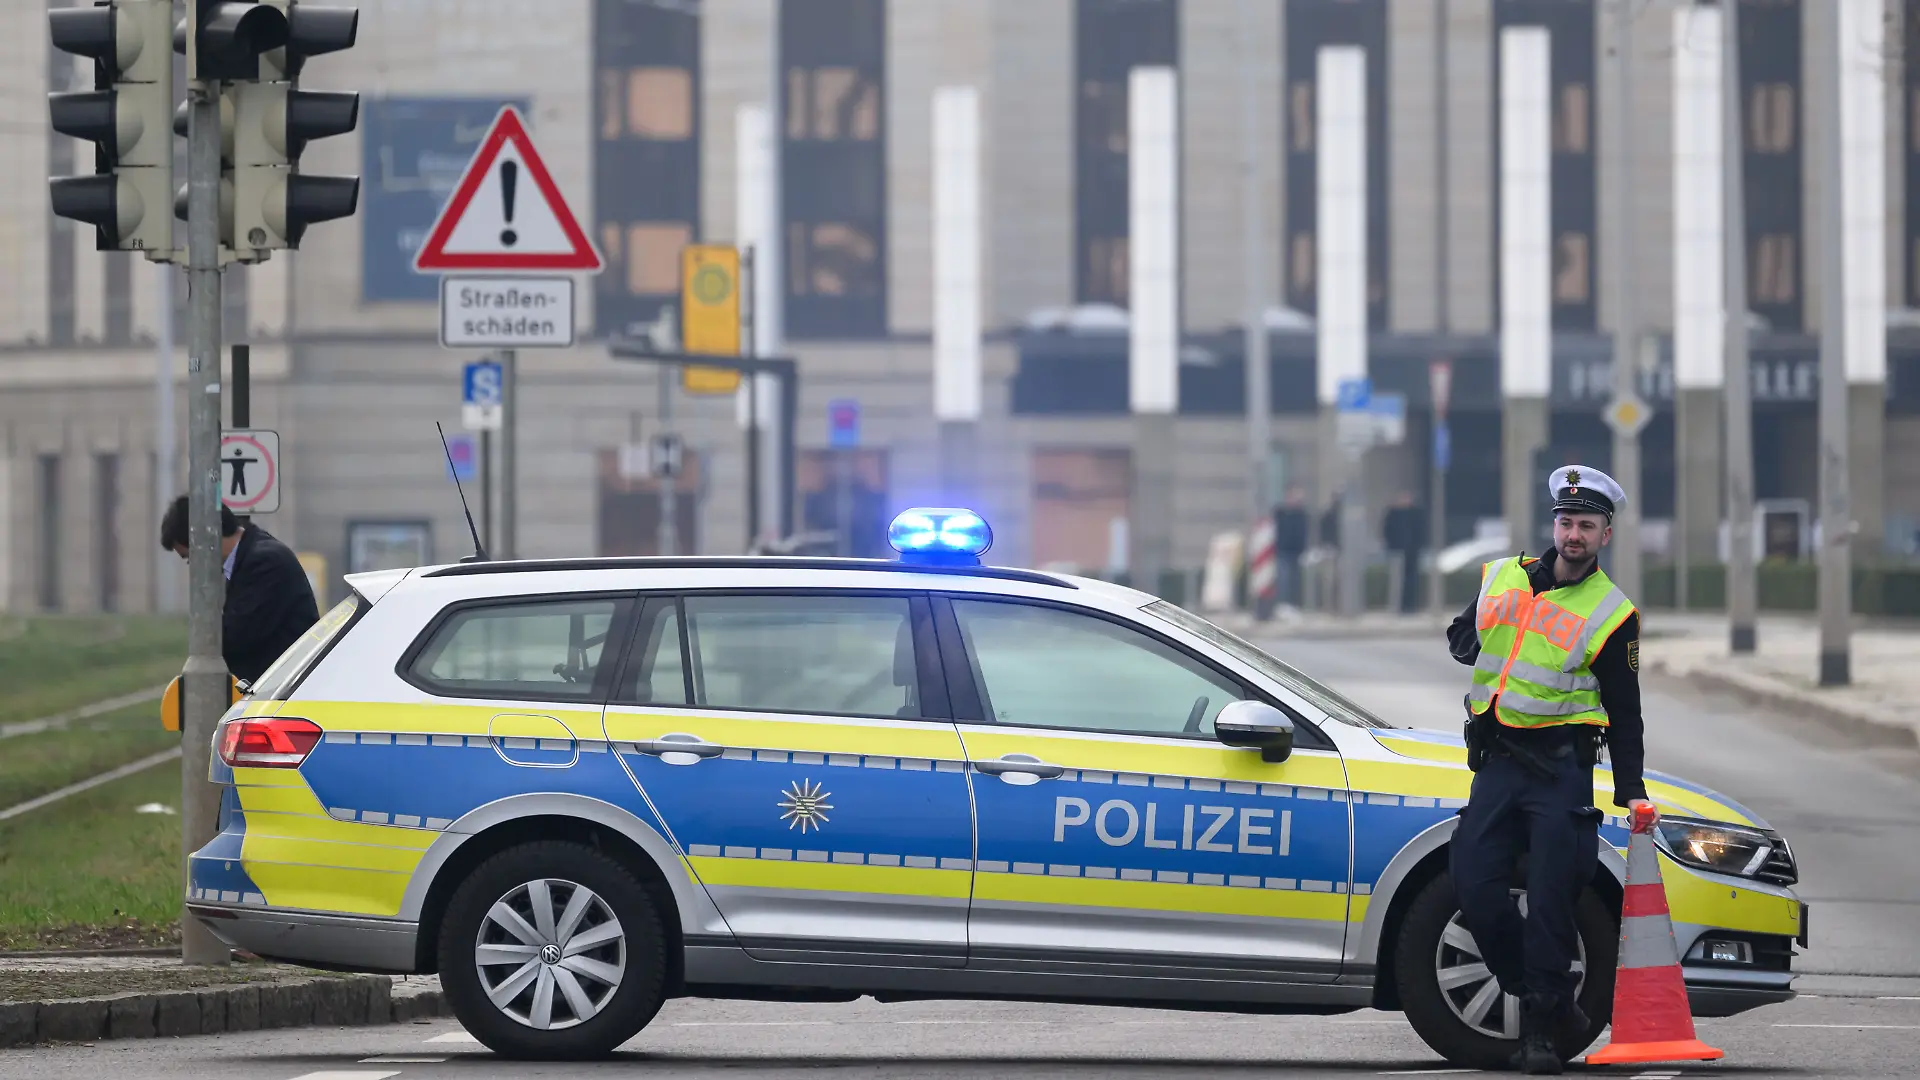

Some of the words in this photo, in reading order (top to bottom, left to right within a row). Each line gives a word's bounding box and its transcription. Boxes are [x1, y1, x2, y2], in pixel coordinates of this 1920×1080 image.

[460, 287, 557, 308] Straßen-
[463, 316, 555, 336] schäden
[471, 367, 500, 403] S
[1053, 796, 1292, 856] POLIZEI
